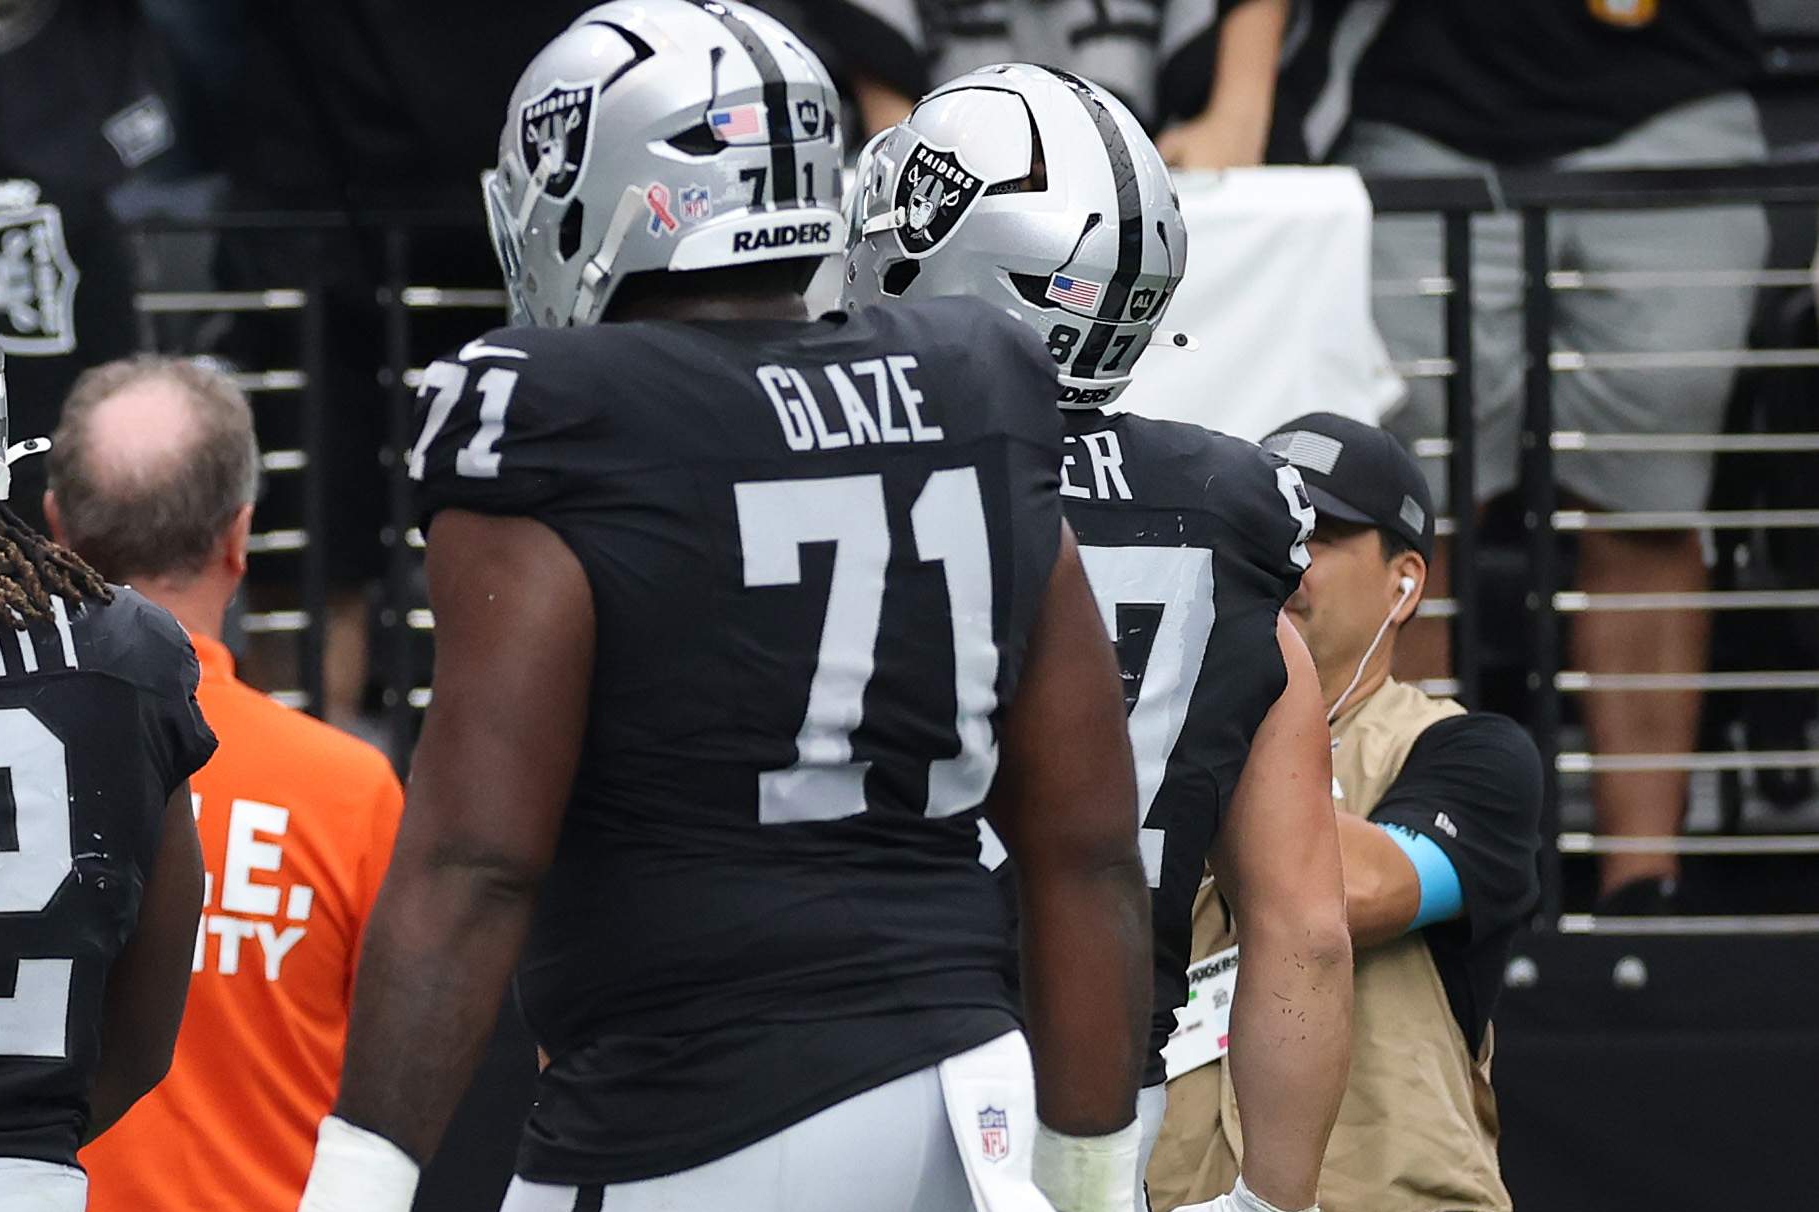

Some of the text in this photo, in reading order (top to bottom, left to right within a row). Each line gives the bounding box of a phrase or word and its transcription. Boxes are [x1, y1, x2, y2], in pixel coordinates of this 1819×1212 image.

[916, 148, 974, 189] RAIDERS
[733, 222, 831, 252] RAIDERS
[407, 360, 519, 480] 71
[756, 355, 944, 451] GLAZE
[733, 466, 1000, 825] 71
